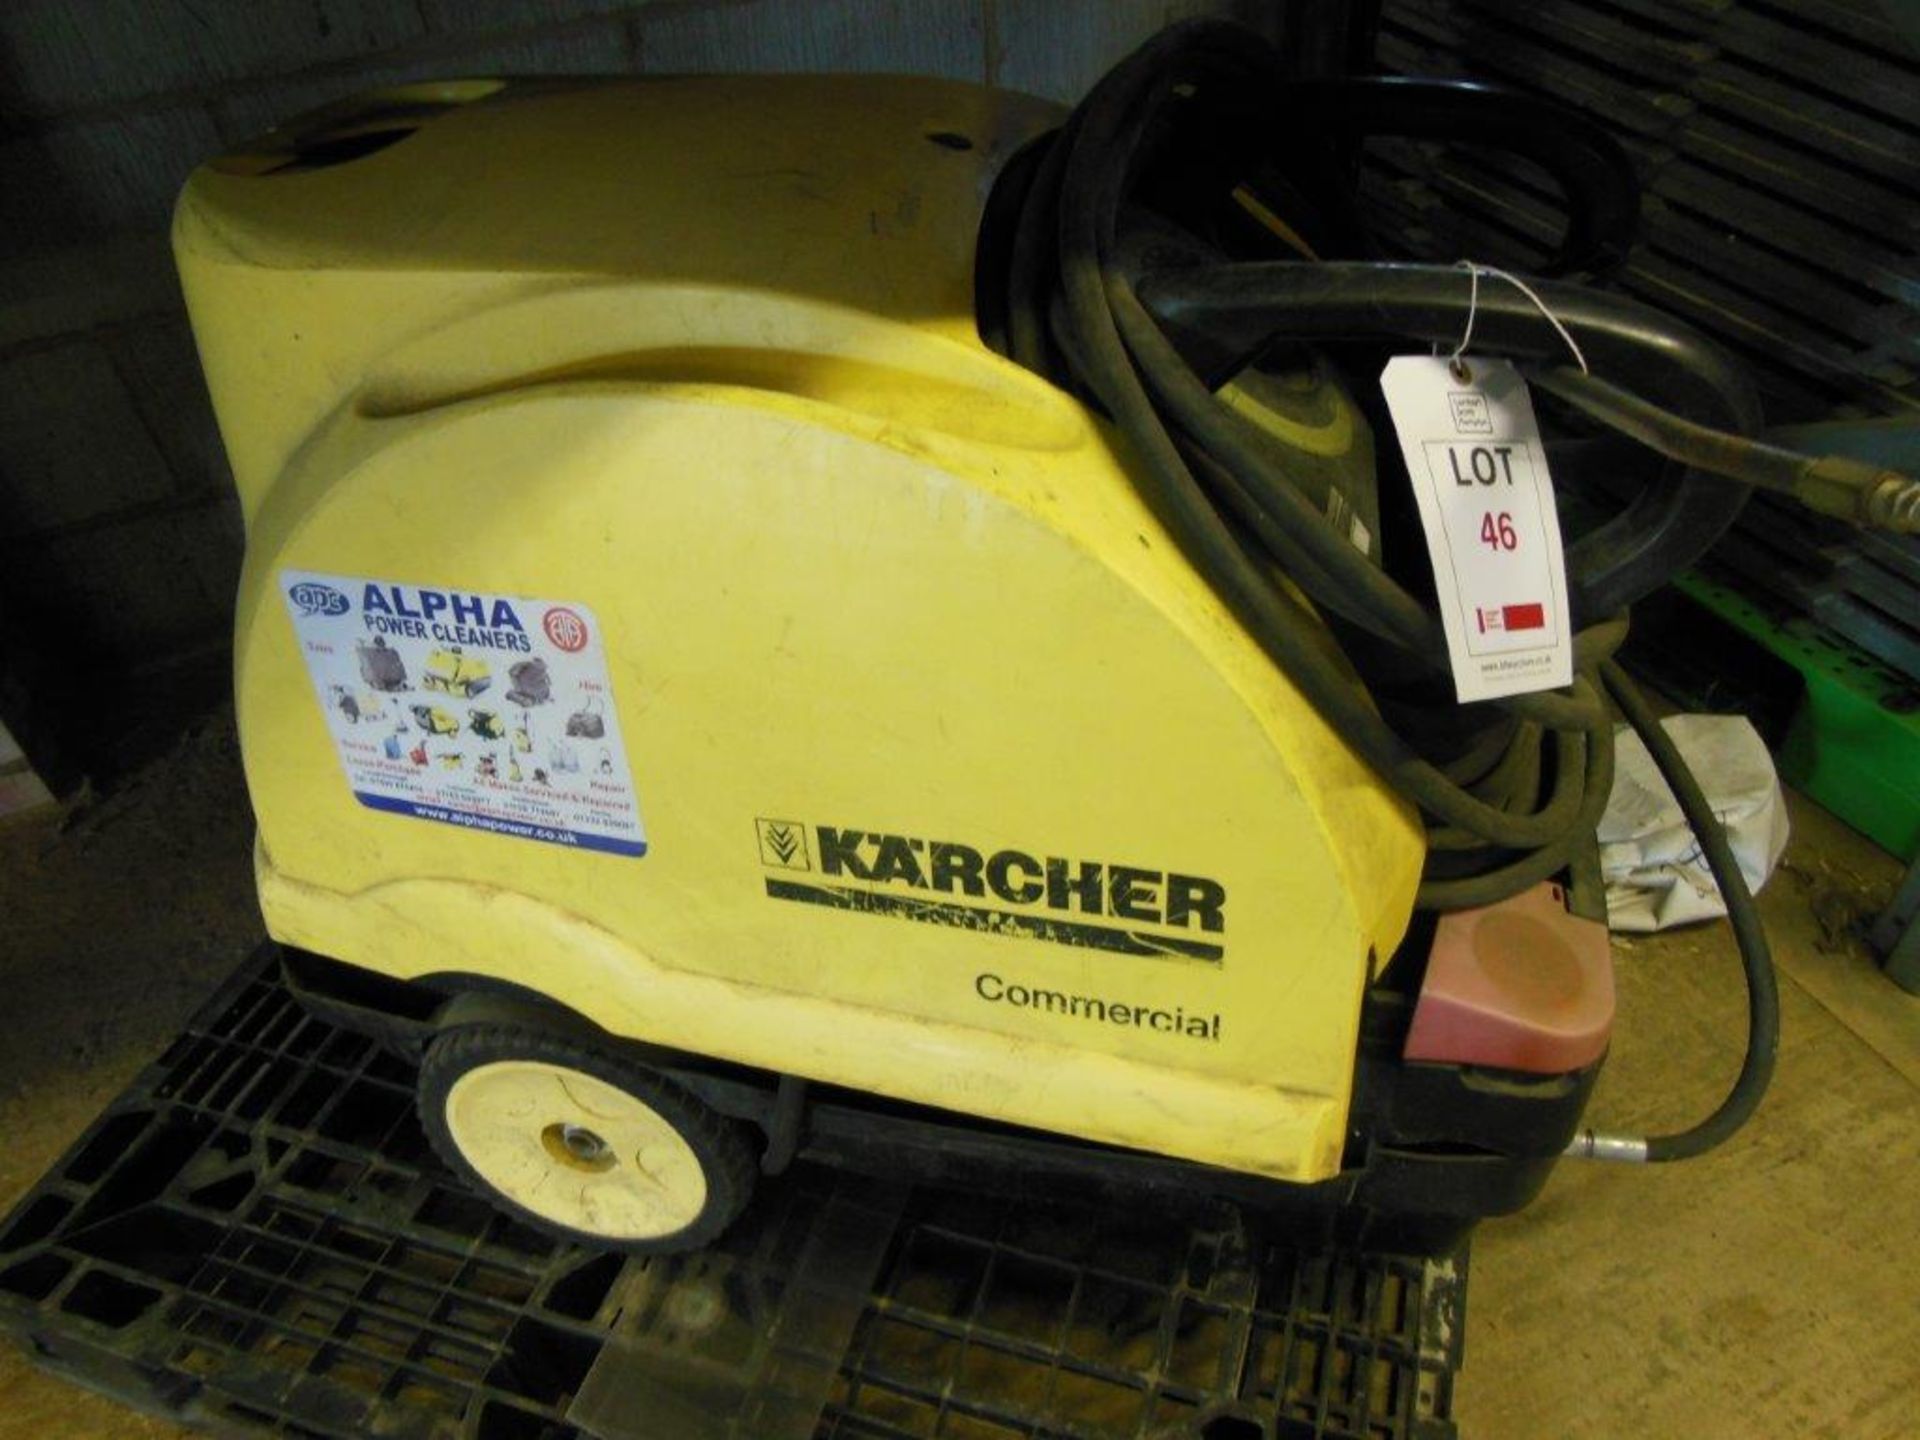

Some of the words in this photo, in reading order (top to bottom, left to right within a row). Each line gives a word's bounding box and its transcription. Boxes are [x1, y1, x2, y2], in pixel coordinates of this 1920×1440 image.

[1449, 447, 1514, 486] LOT
[1481, 512, 1517, 551] 46
[362, 583, 525, 632] ALPHA
[364, 614, 427, 640] POWER
[431, 624, 533, 653] CLEANERS
[974, 972, 1222, 1042] Commercial
